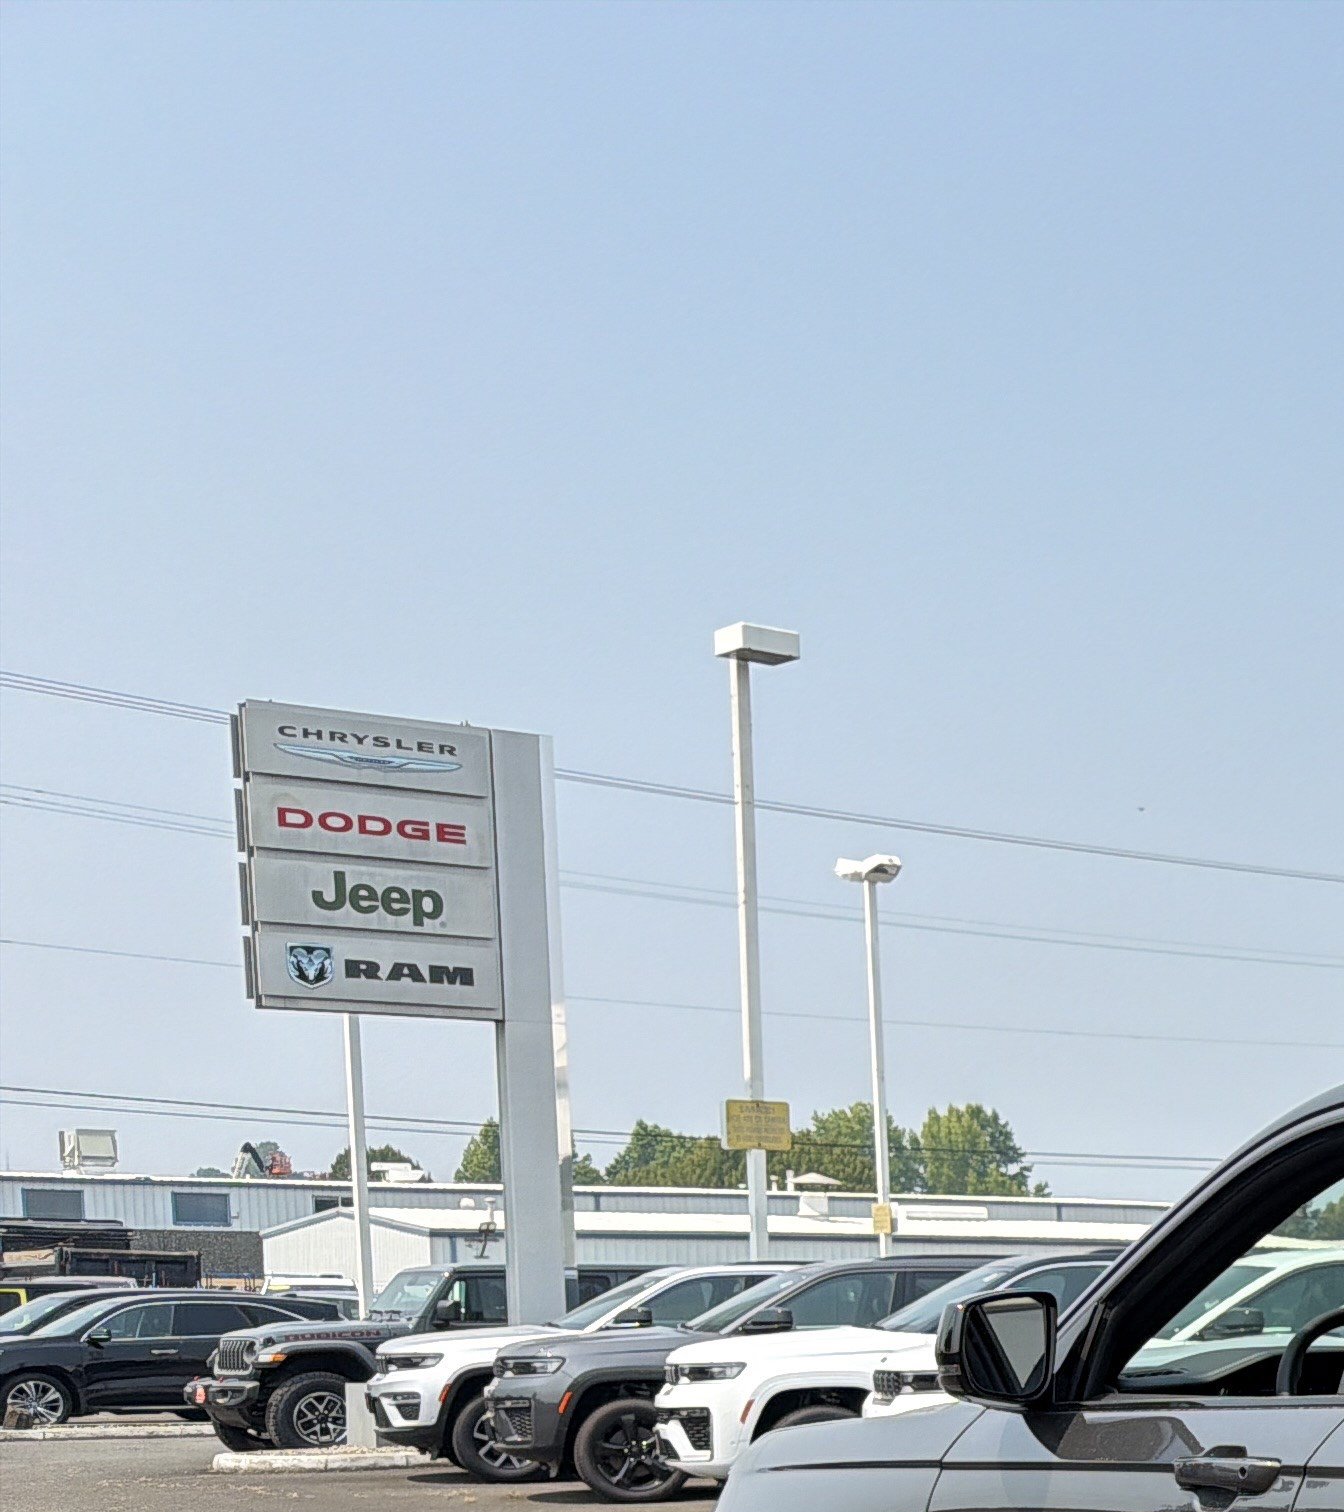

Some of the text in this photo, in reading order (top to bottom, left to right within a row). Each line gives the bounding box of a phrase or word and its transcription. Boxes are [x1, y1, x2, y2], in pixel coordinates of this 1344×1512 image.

[277, 725, 458, 757] CHRYSLER
[276, 806, 467, 845] DODGE
[311, 870, 444, 927] Jeep
[344, 958, 475, 986] RAM
[284, 1329, 381, 1342] RUBICON
